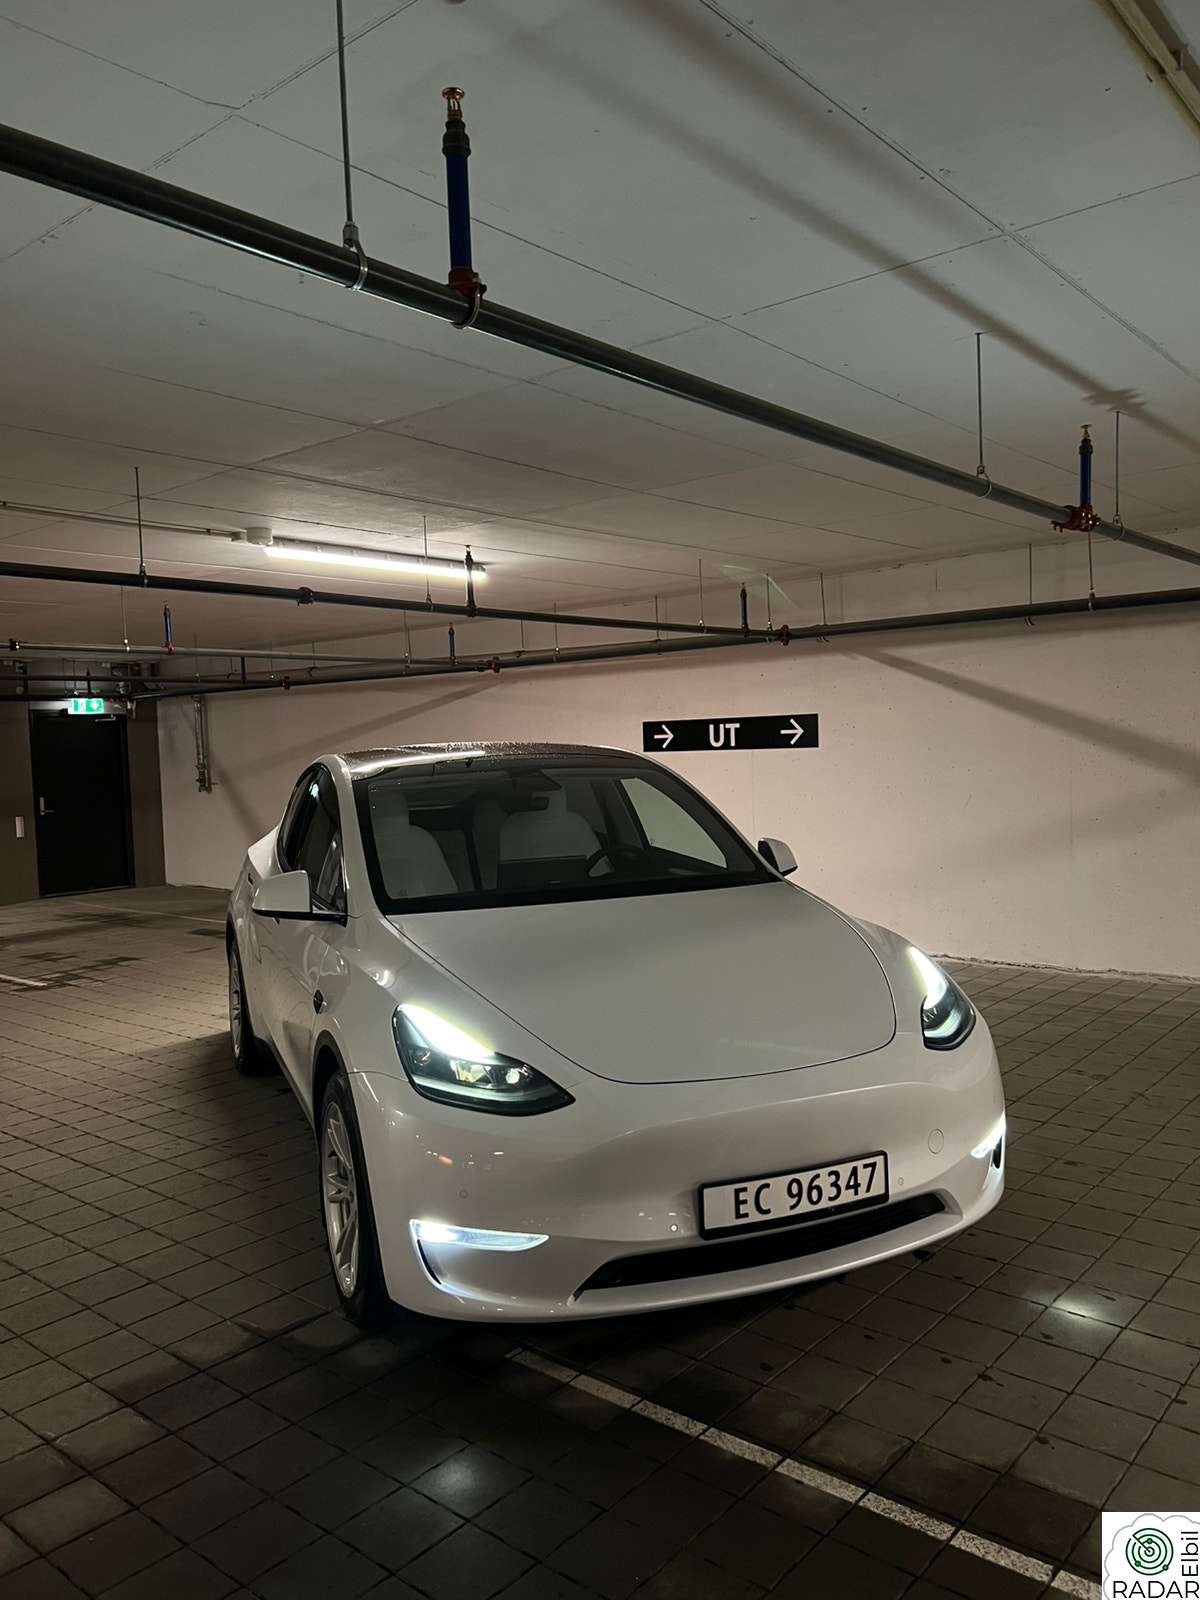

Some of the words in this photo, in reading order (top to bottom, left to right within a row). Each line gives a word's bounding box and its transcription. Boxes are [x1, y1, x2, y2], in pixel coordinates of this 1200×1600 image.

[709, 723, 740, 747] UT
[734, 1182, 772, 1219] EC
[787, 1161, 877, 1210] 96347
